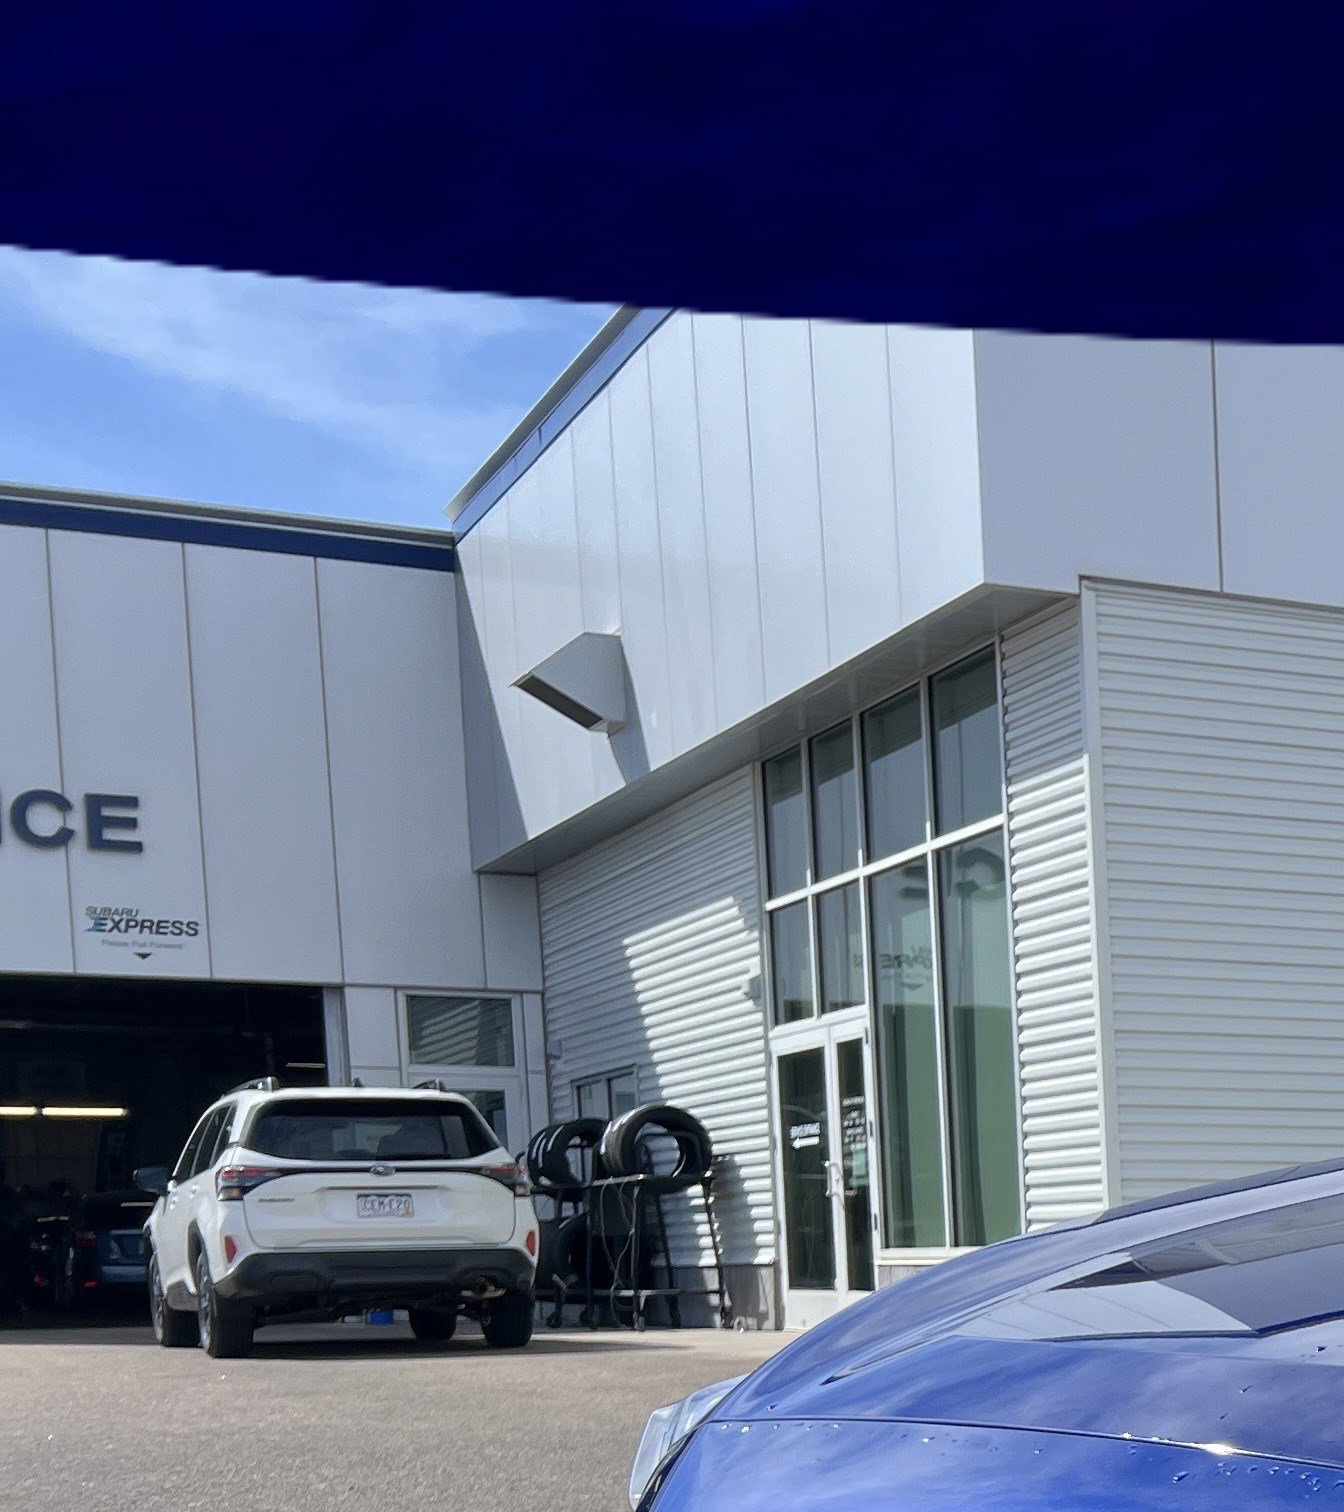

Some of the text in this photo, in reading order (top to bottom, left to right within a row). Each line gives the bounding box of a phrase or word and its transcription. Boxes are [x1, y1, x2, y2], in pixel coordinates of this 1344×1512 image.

[0, 788, 144, 854] CE
[85, 905, 139, 918] SUBARU
[85, 916, 200, 937] EXPRESS
